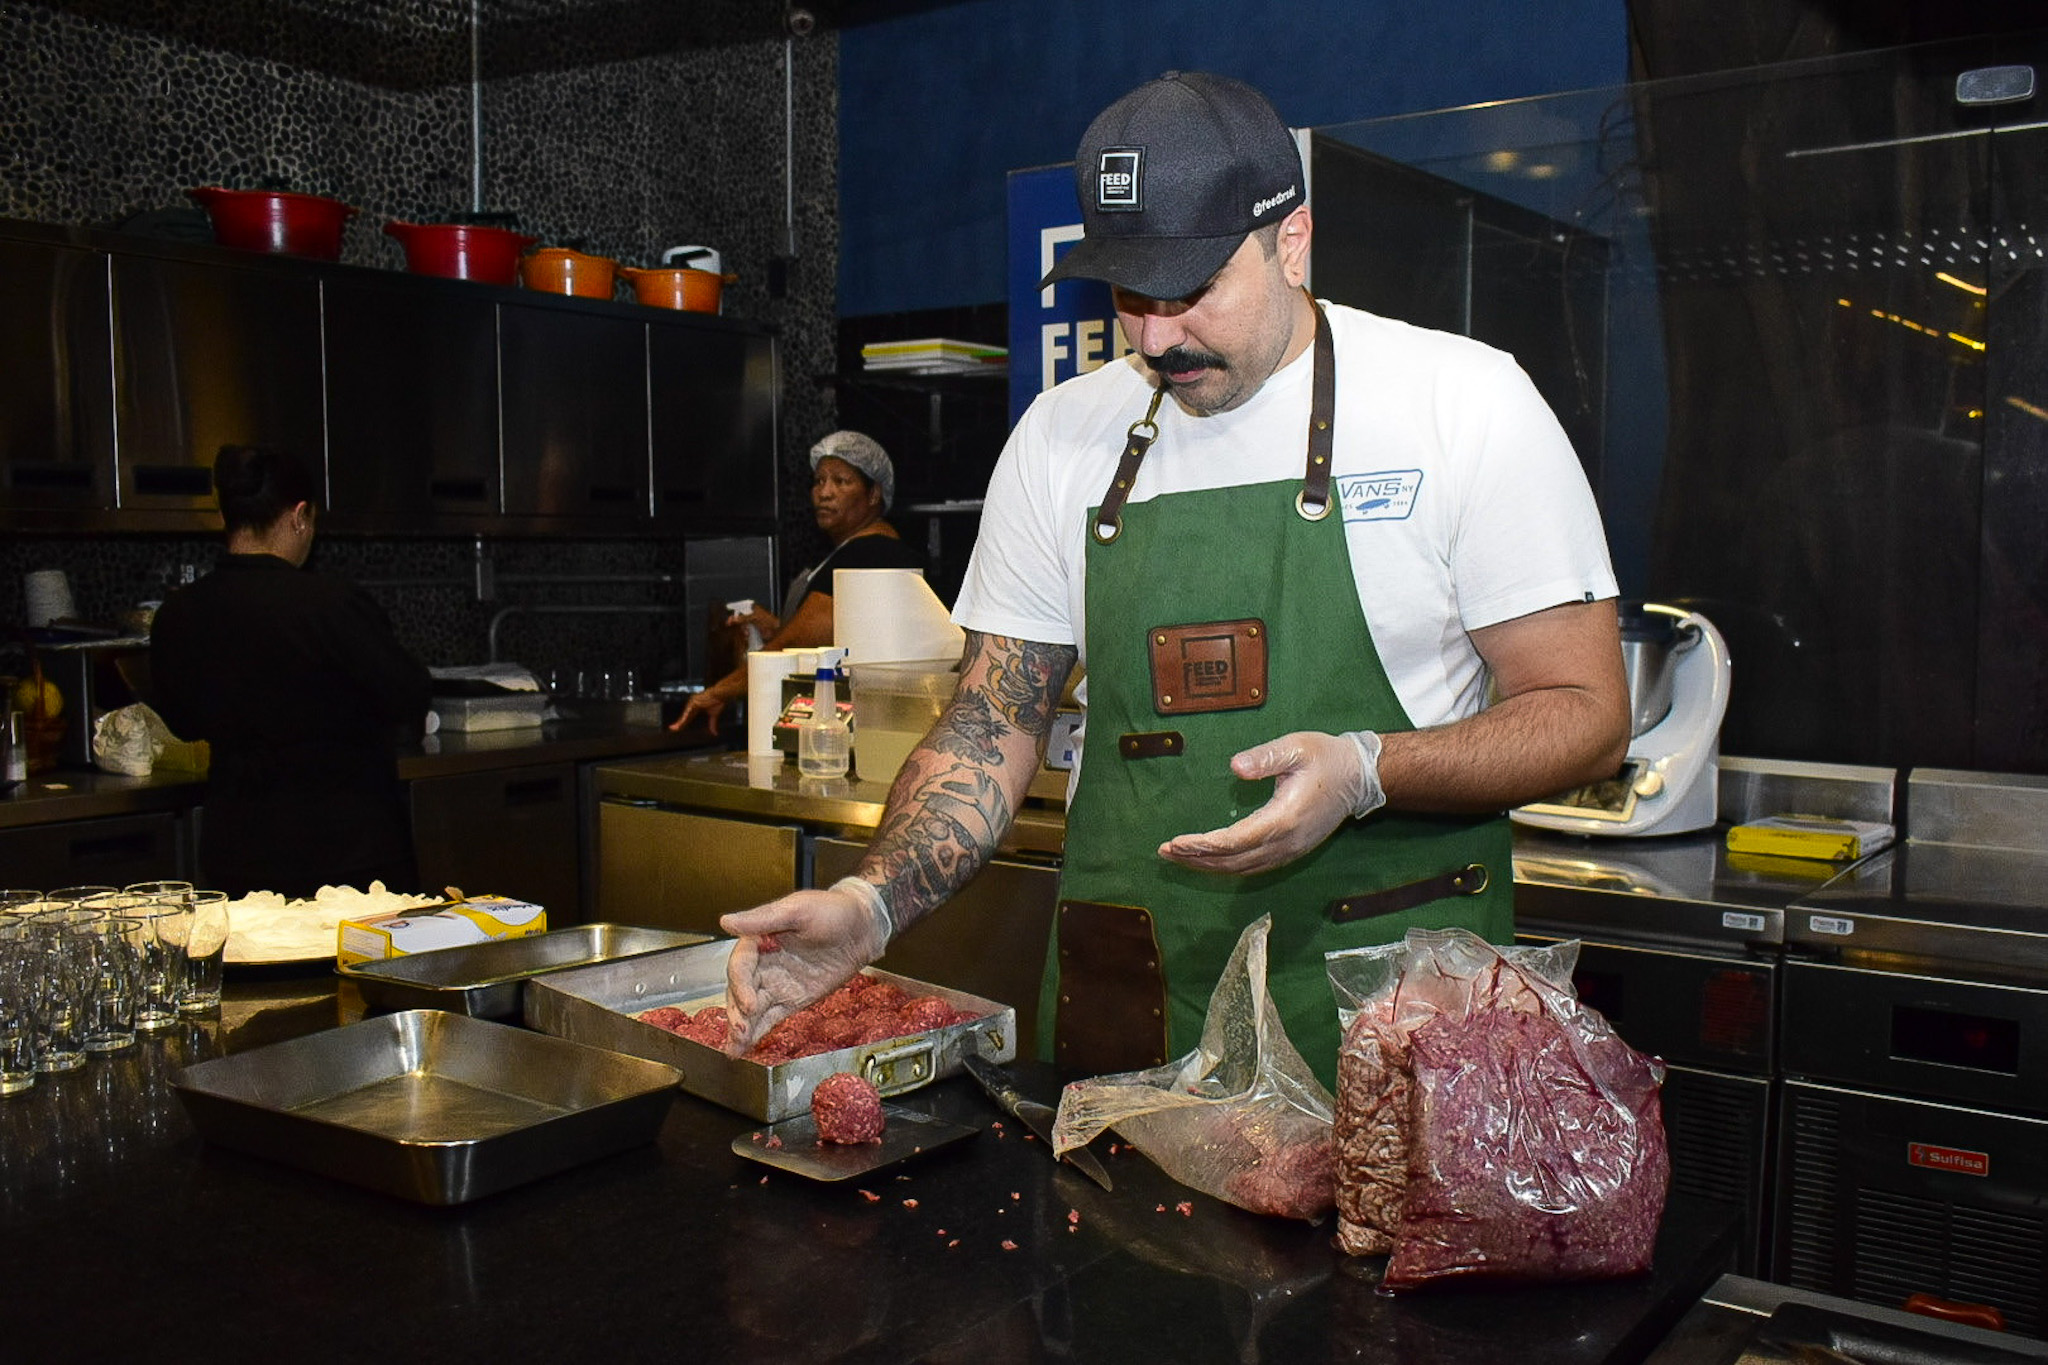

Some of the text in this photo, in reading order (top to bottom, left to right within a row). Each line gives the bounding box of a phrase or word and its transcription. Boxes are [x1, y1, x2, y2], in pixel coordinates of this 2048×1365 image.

[1101, 173, 1131, 186] FEED
[1341, 478, 1402, 499] VANS
[1183, 660, 1229, 676] FEED
[1929, 1151, 1984, 1169] Sulfisa
